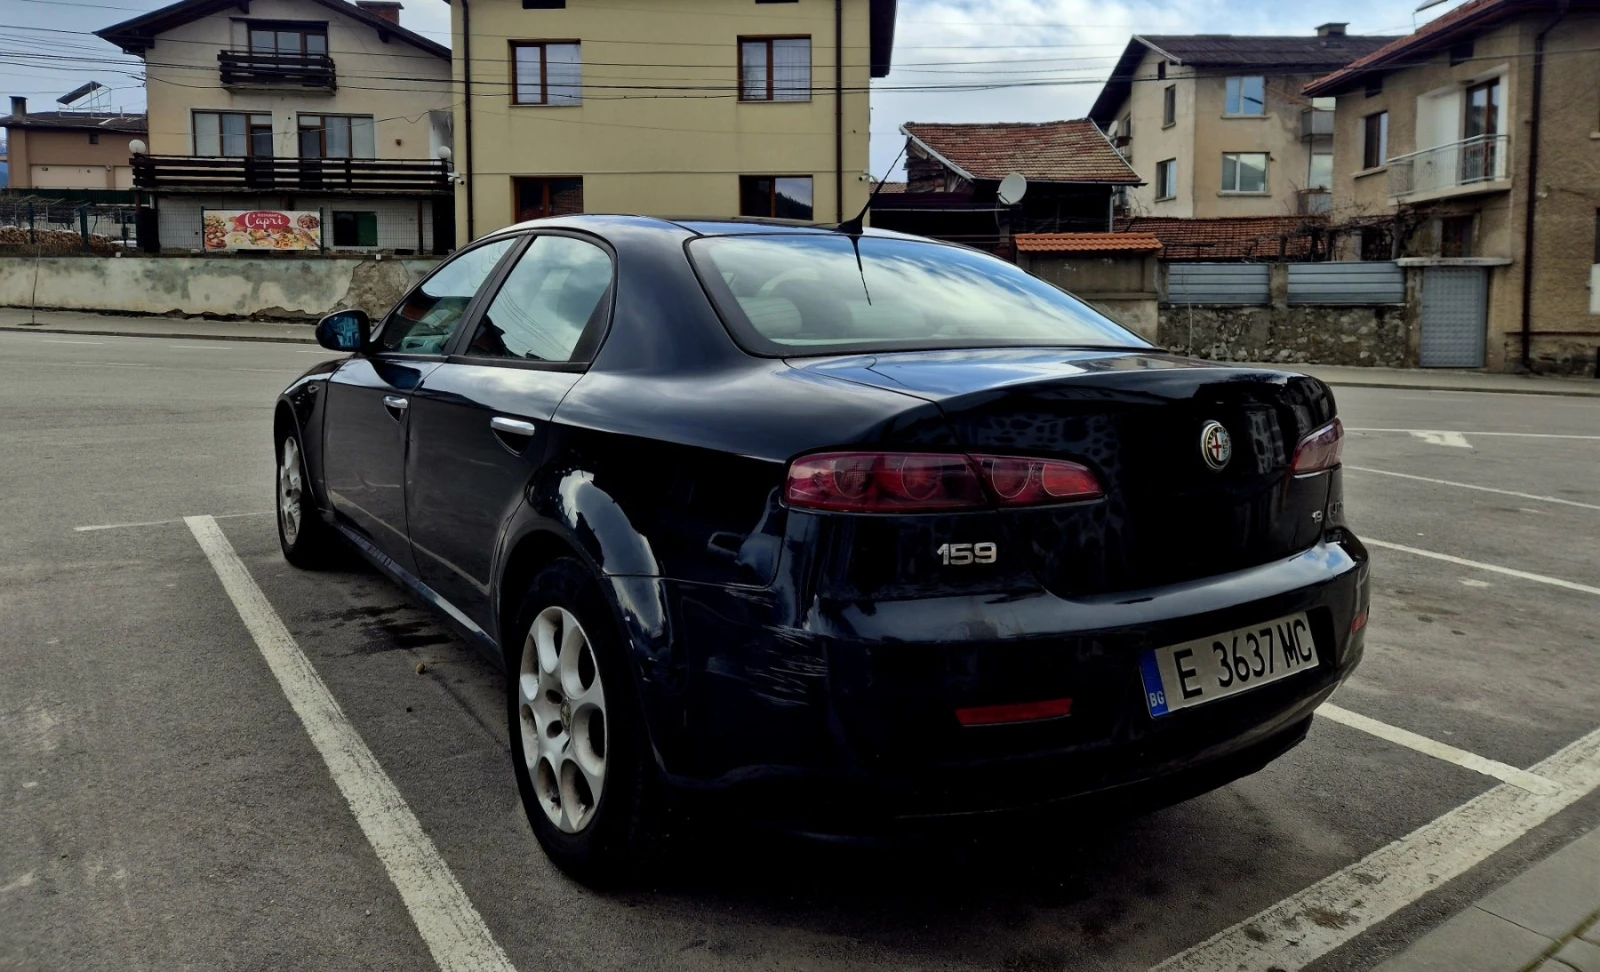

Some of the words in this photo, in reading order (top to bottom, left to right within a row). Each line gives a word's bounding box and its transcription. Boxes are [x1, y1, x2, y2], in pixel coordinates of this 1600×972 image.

[245, 213, 283, 229] Capri
[937, 542, 997, 565] 159
[1149, 691, 1165, 707] BG
[1173, 648, 1203, 700] E
[1212, 627, 1274, 688] 3637
[1276, 619, 1313, 668] MC
